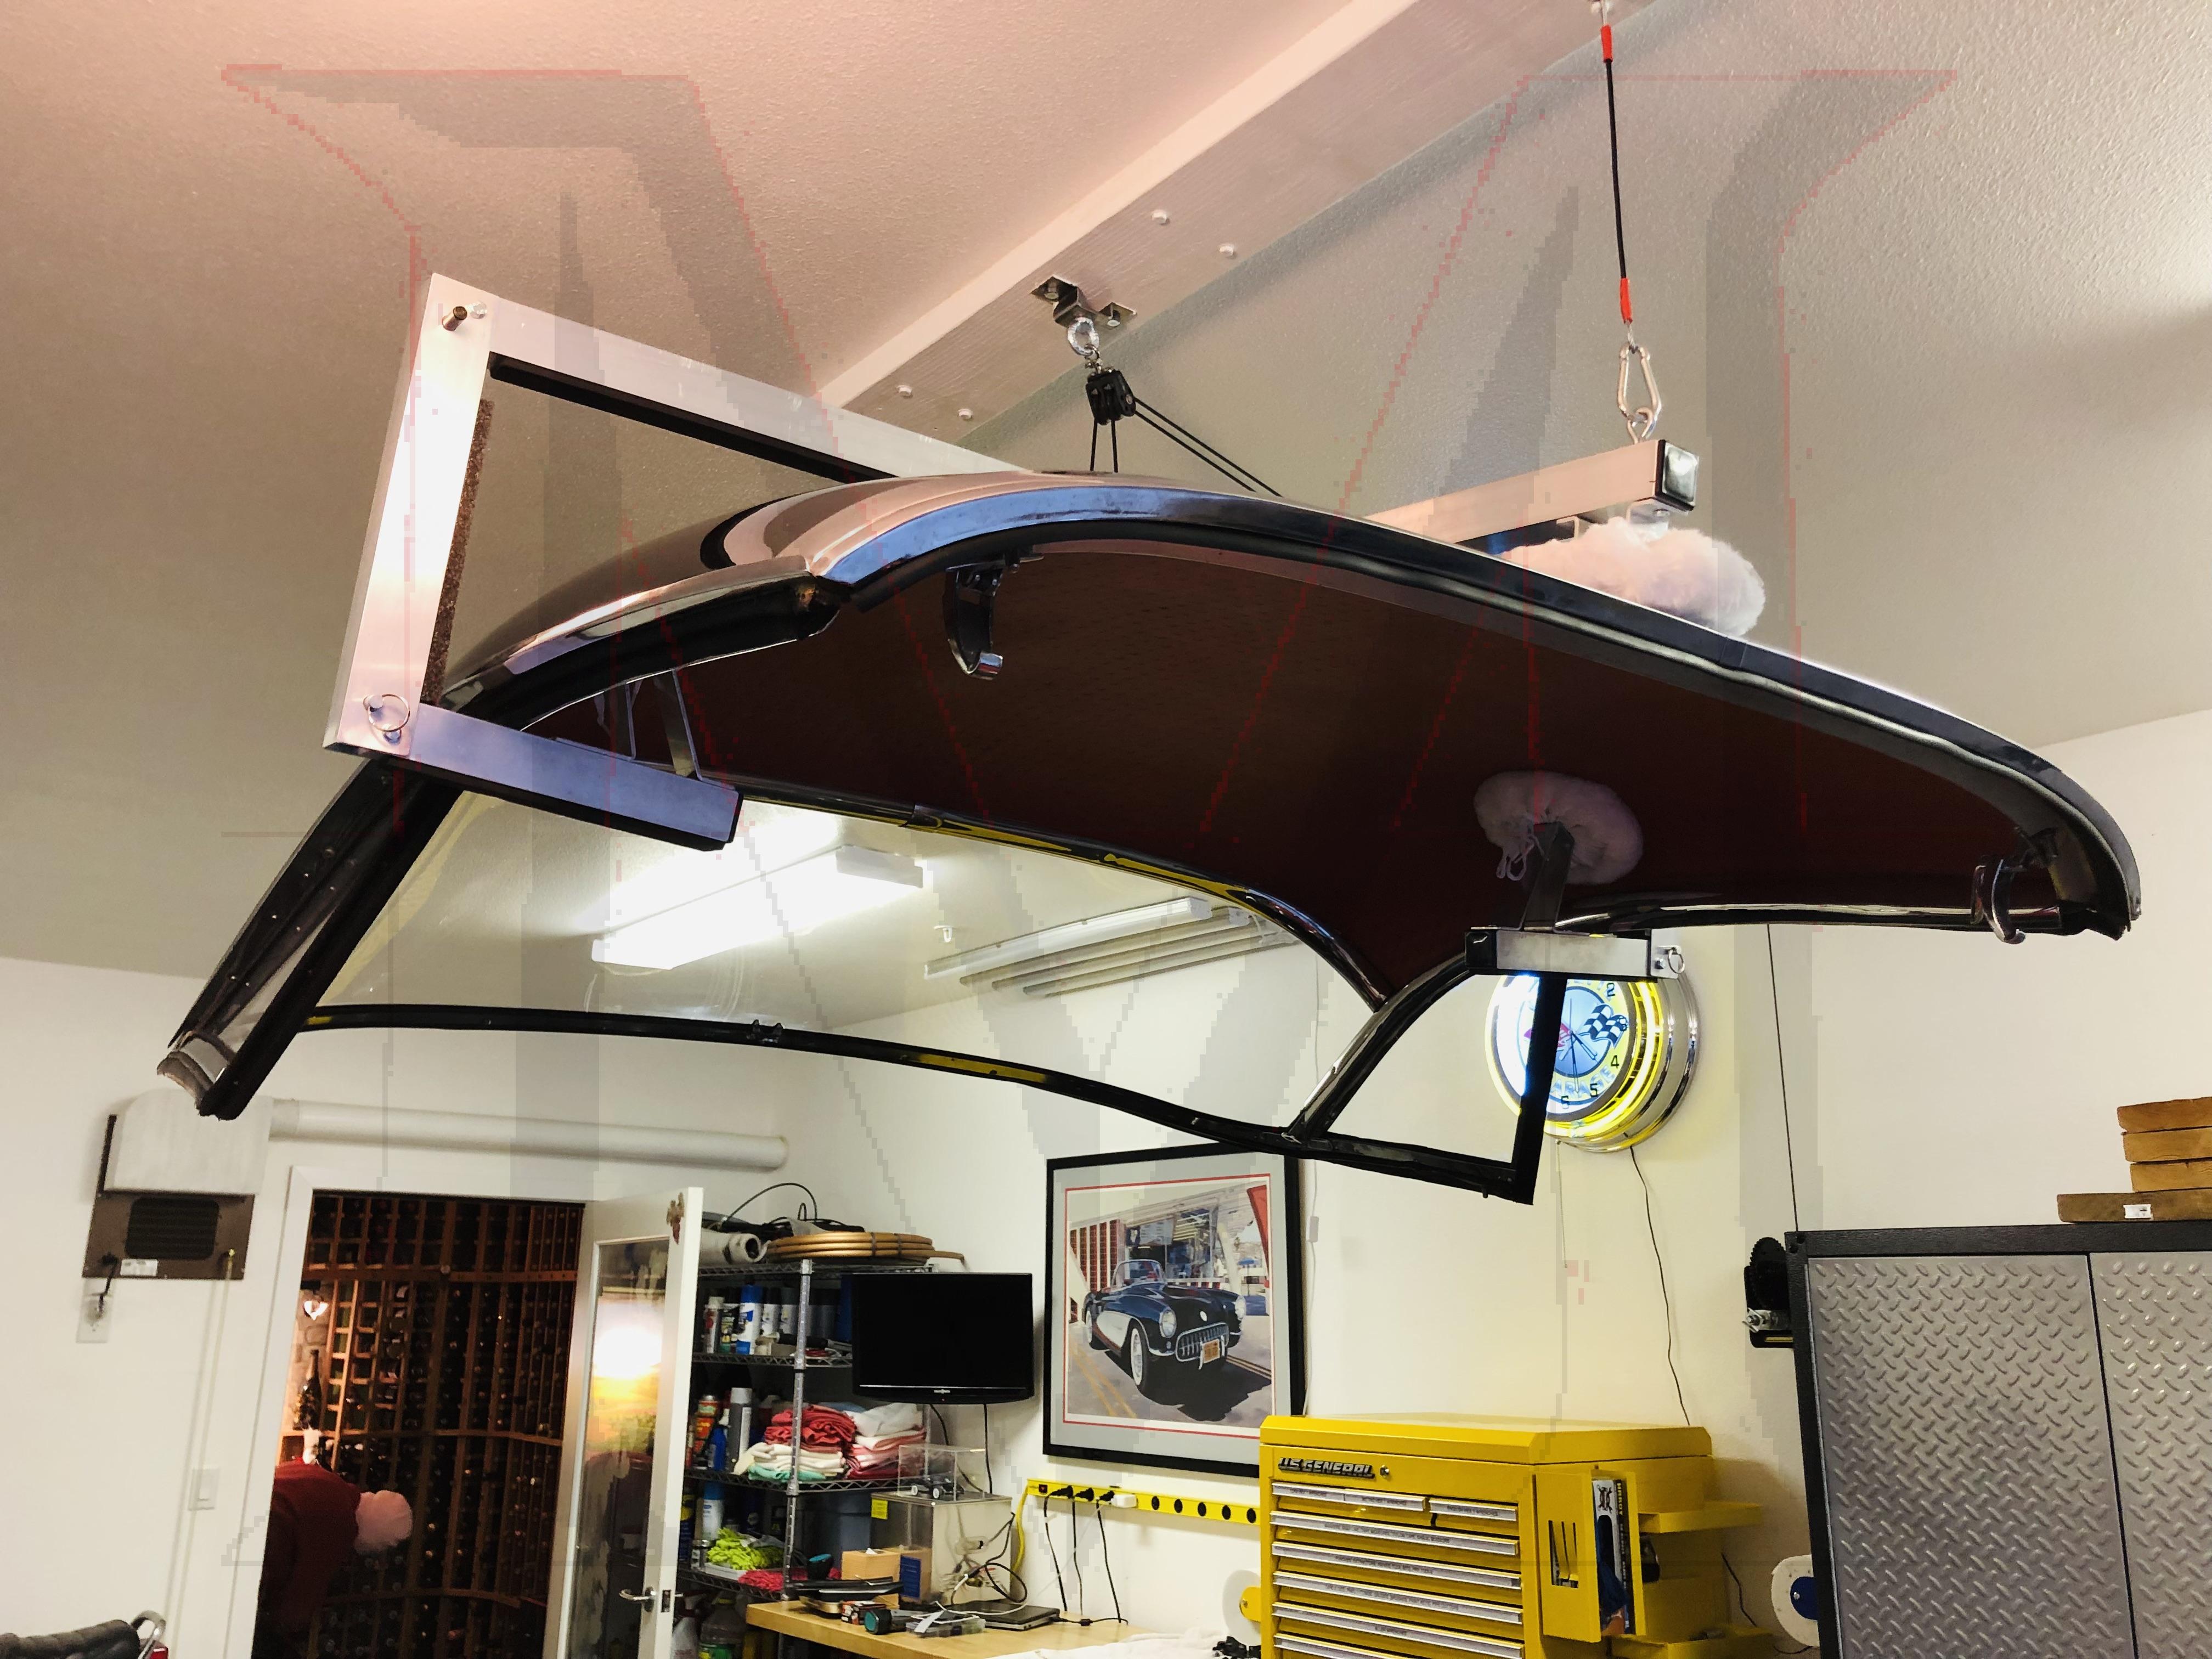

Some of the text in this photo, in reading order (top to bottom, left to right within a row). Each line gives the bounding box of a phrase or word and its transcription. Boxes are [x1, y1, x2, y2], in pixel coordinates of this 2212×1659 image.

[1606, 983, 1616, 997] 2
[1610, 1055, 1620, 1069] 4
[1550, 1065, 1616, 1098] ARAGE
[1590, 1083, 1598, 1097] 5
[1303, 1459, 1375, 1477] GENERAL
